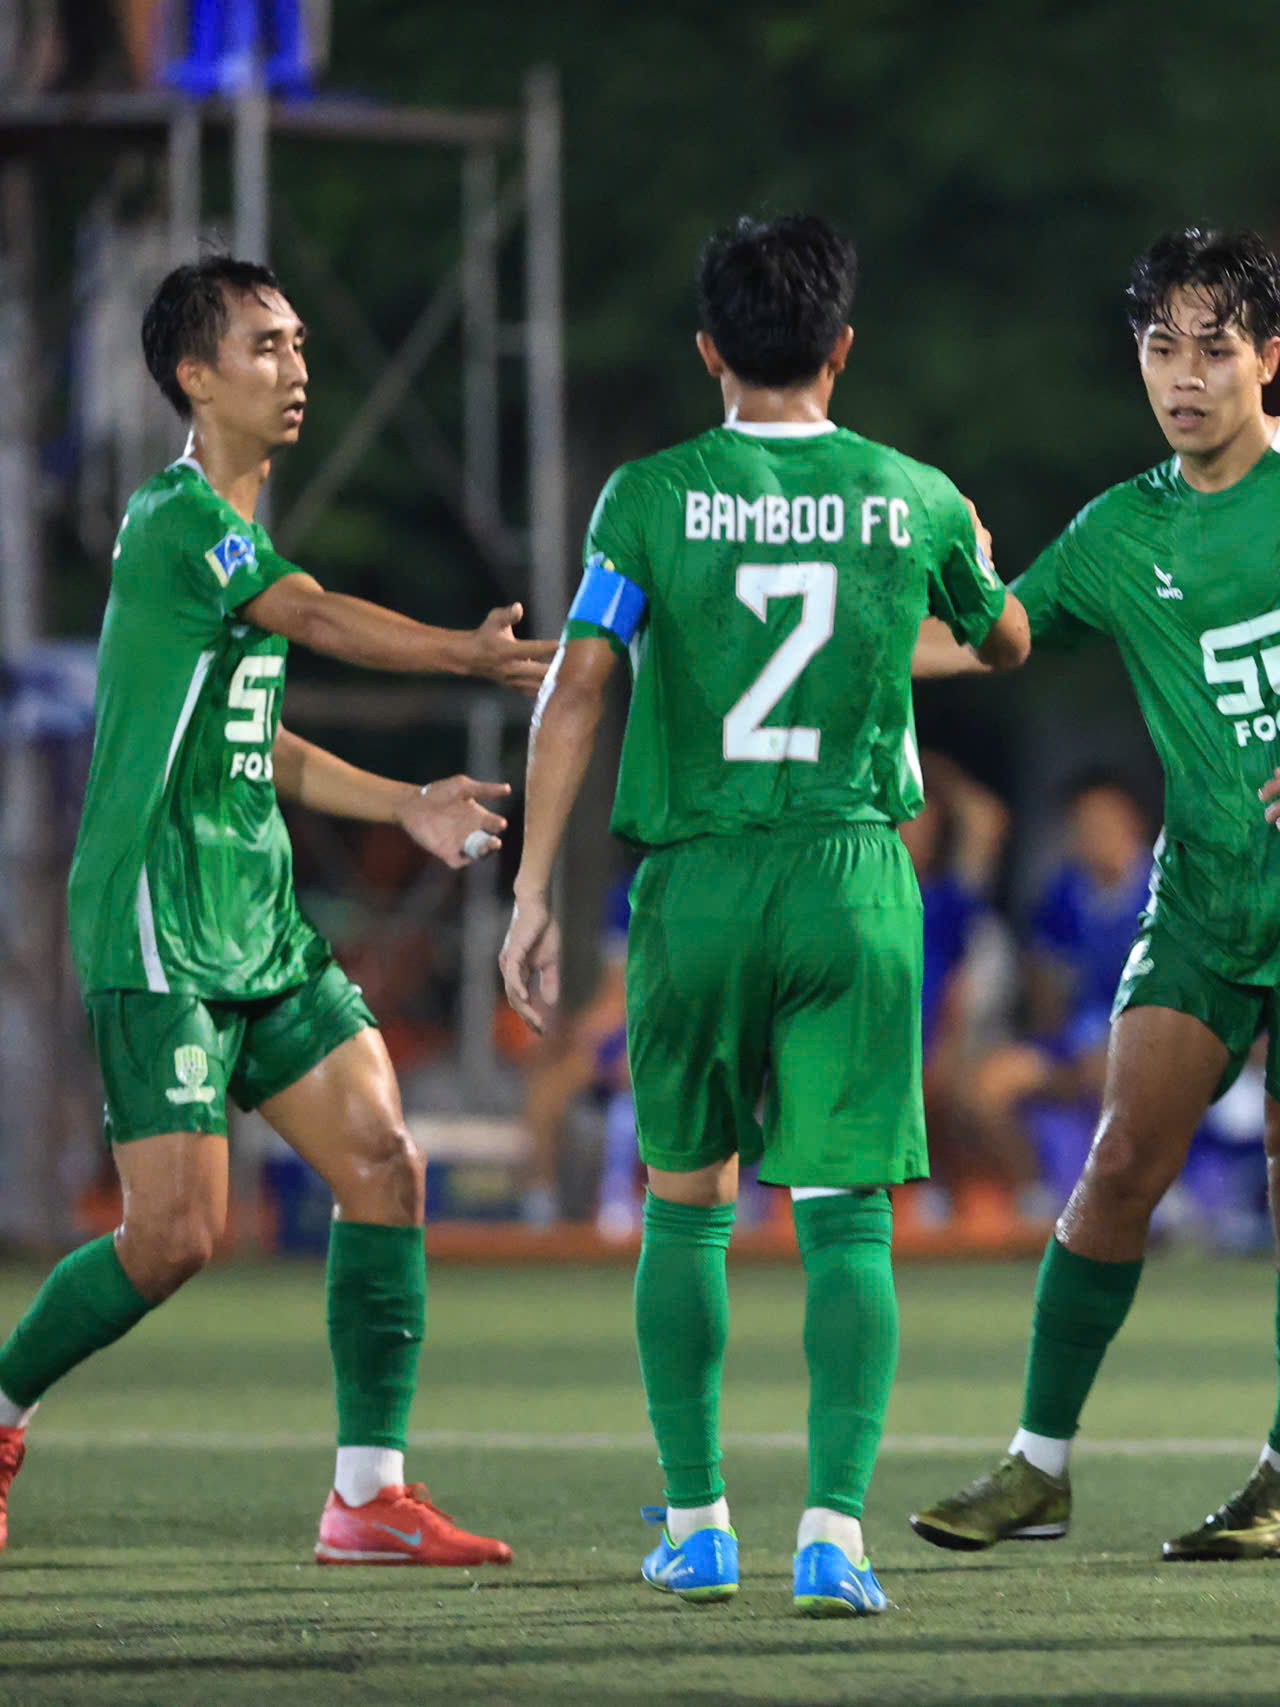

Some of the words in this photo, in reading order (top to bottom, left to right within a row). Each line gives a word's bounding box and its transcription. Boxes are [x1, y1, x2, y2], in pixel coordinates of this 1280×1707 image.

[686, 490, 844, 544] BAMBOO
[861, 496, 911, 547] FC
[224, 655, 285, 743] S
[722, 561, 838, 763] 2
